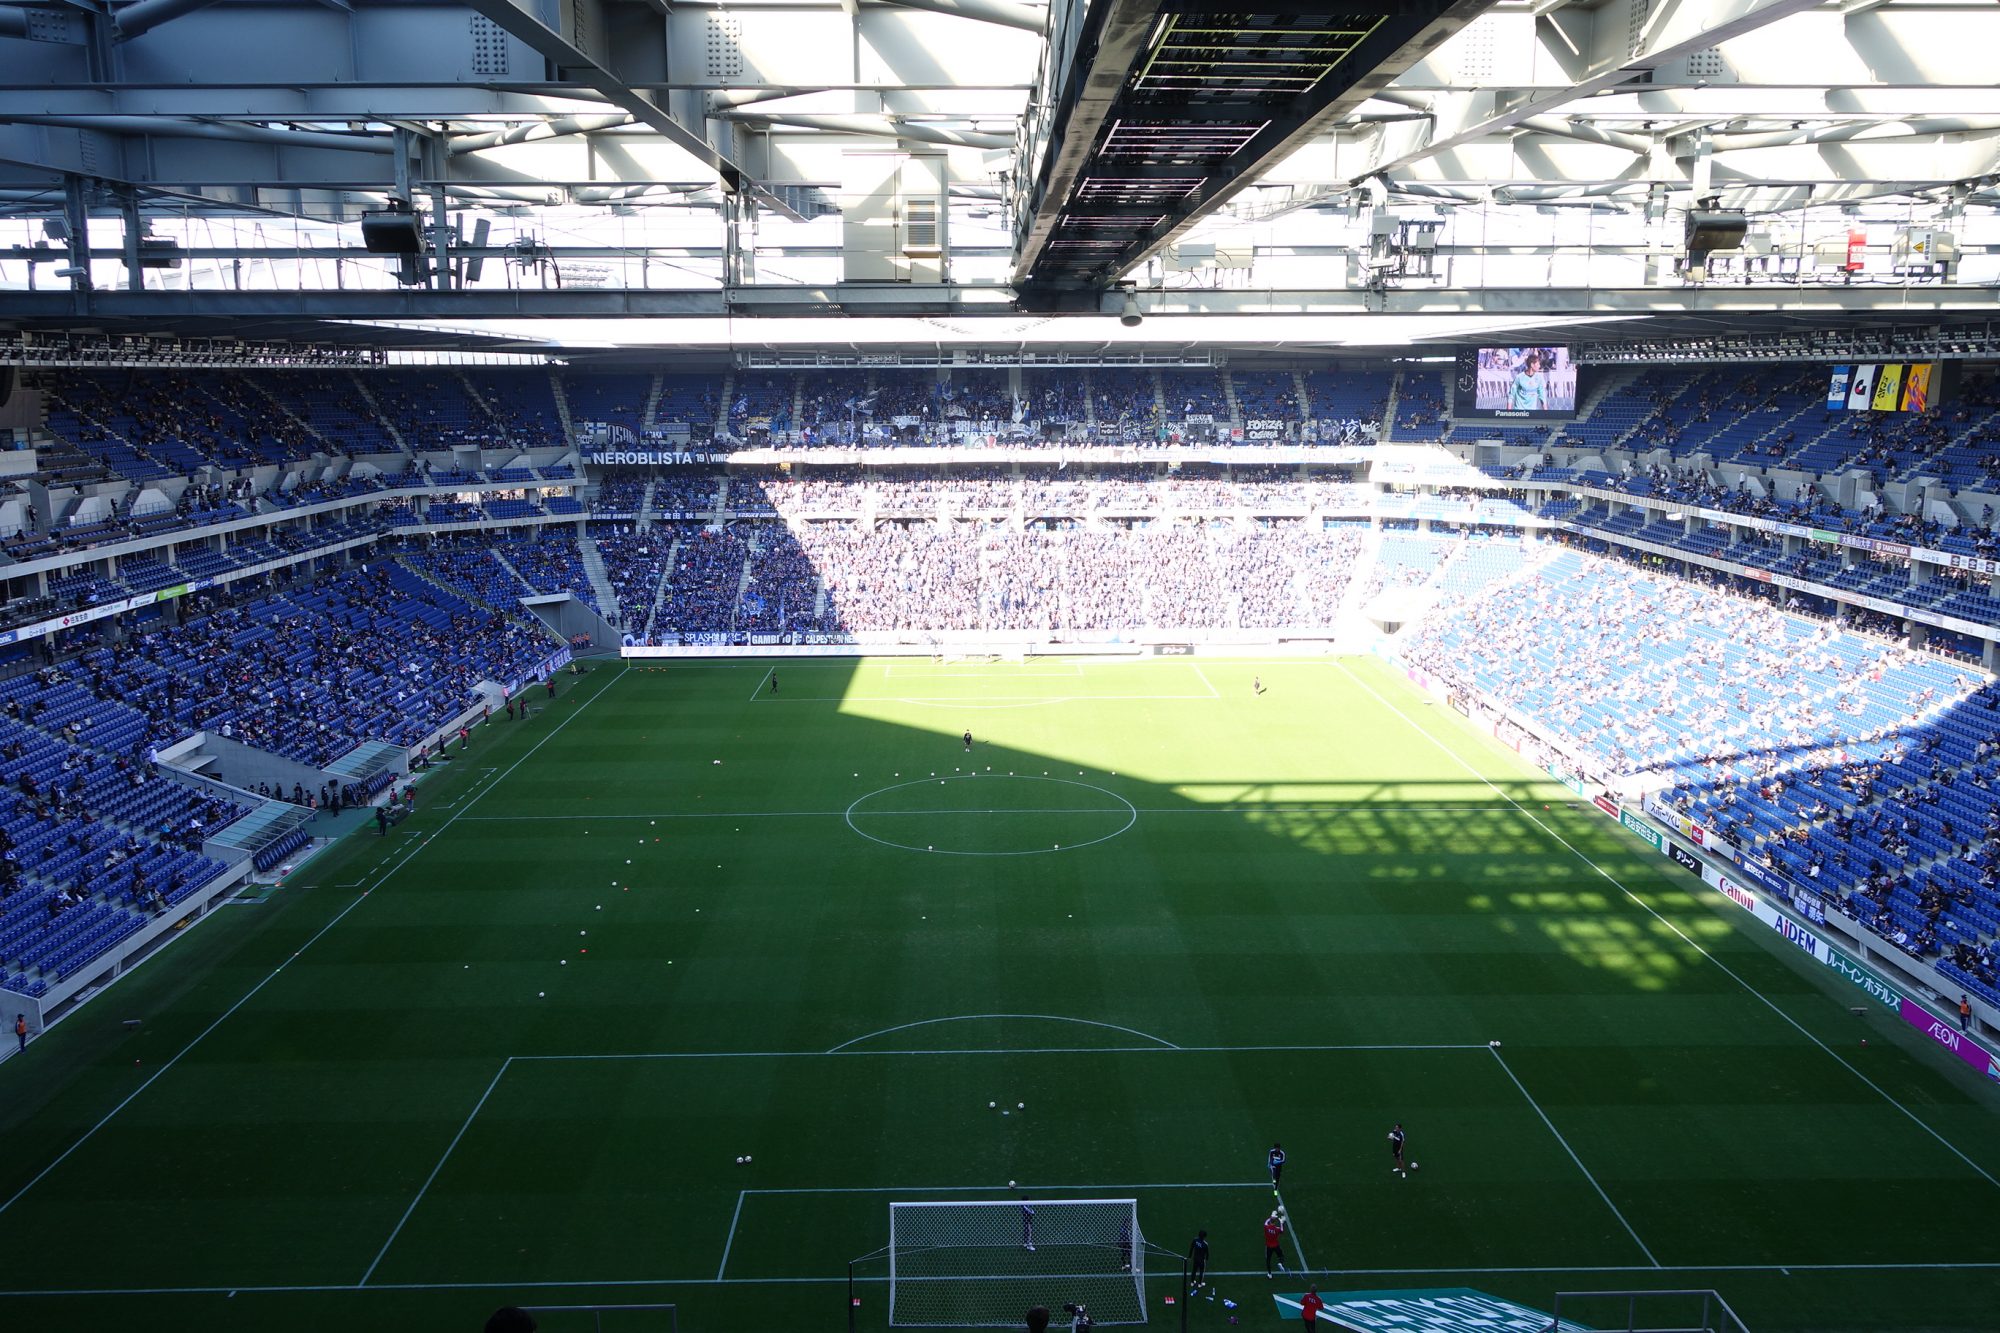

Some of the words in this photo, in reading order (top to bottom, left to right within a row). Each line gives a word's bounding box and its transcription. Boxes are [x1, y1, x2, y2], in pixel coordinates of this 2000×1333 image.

[593, 452, 693, 465] NEROBLISTA
[1881, 543, 1908, 555] TAKENAKA
[1777, 575, 1800, 589] FUTABA
[1650, 801, 1681, 829] スポーツくじ
[1624, 813, 1658, 845] 明治安田生命
[1719, 877, 1754, 912] Canon
